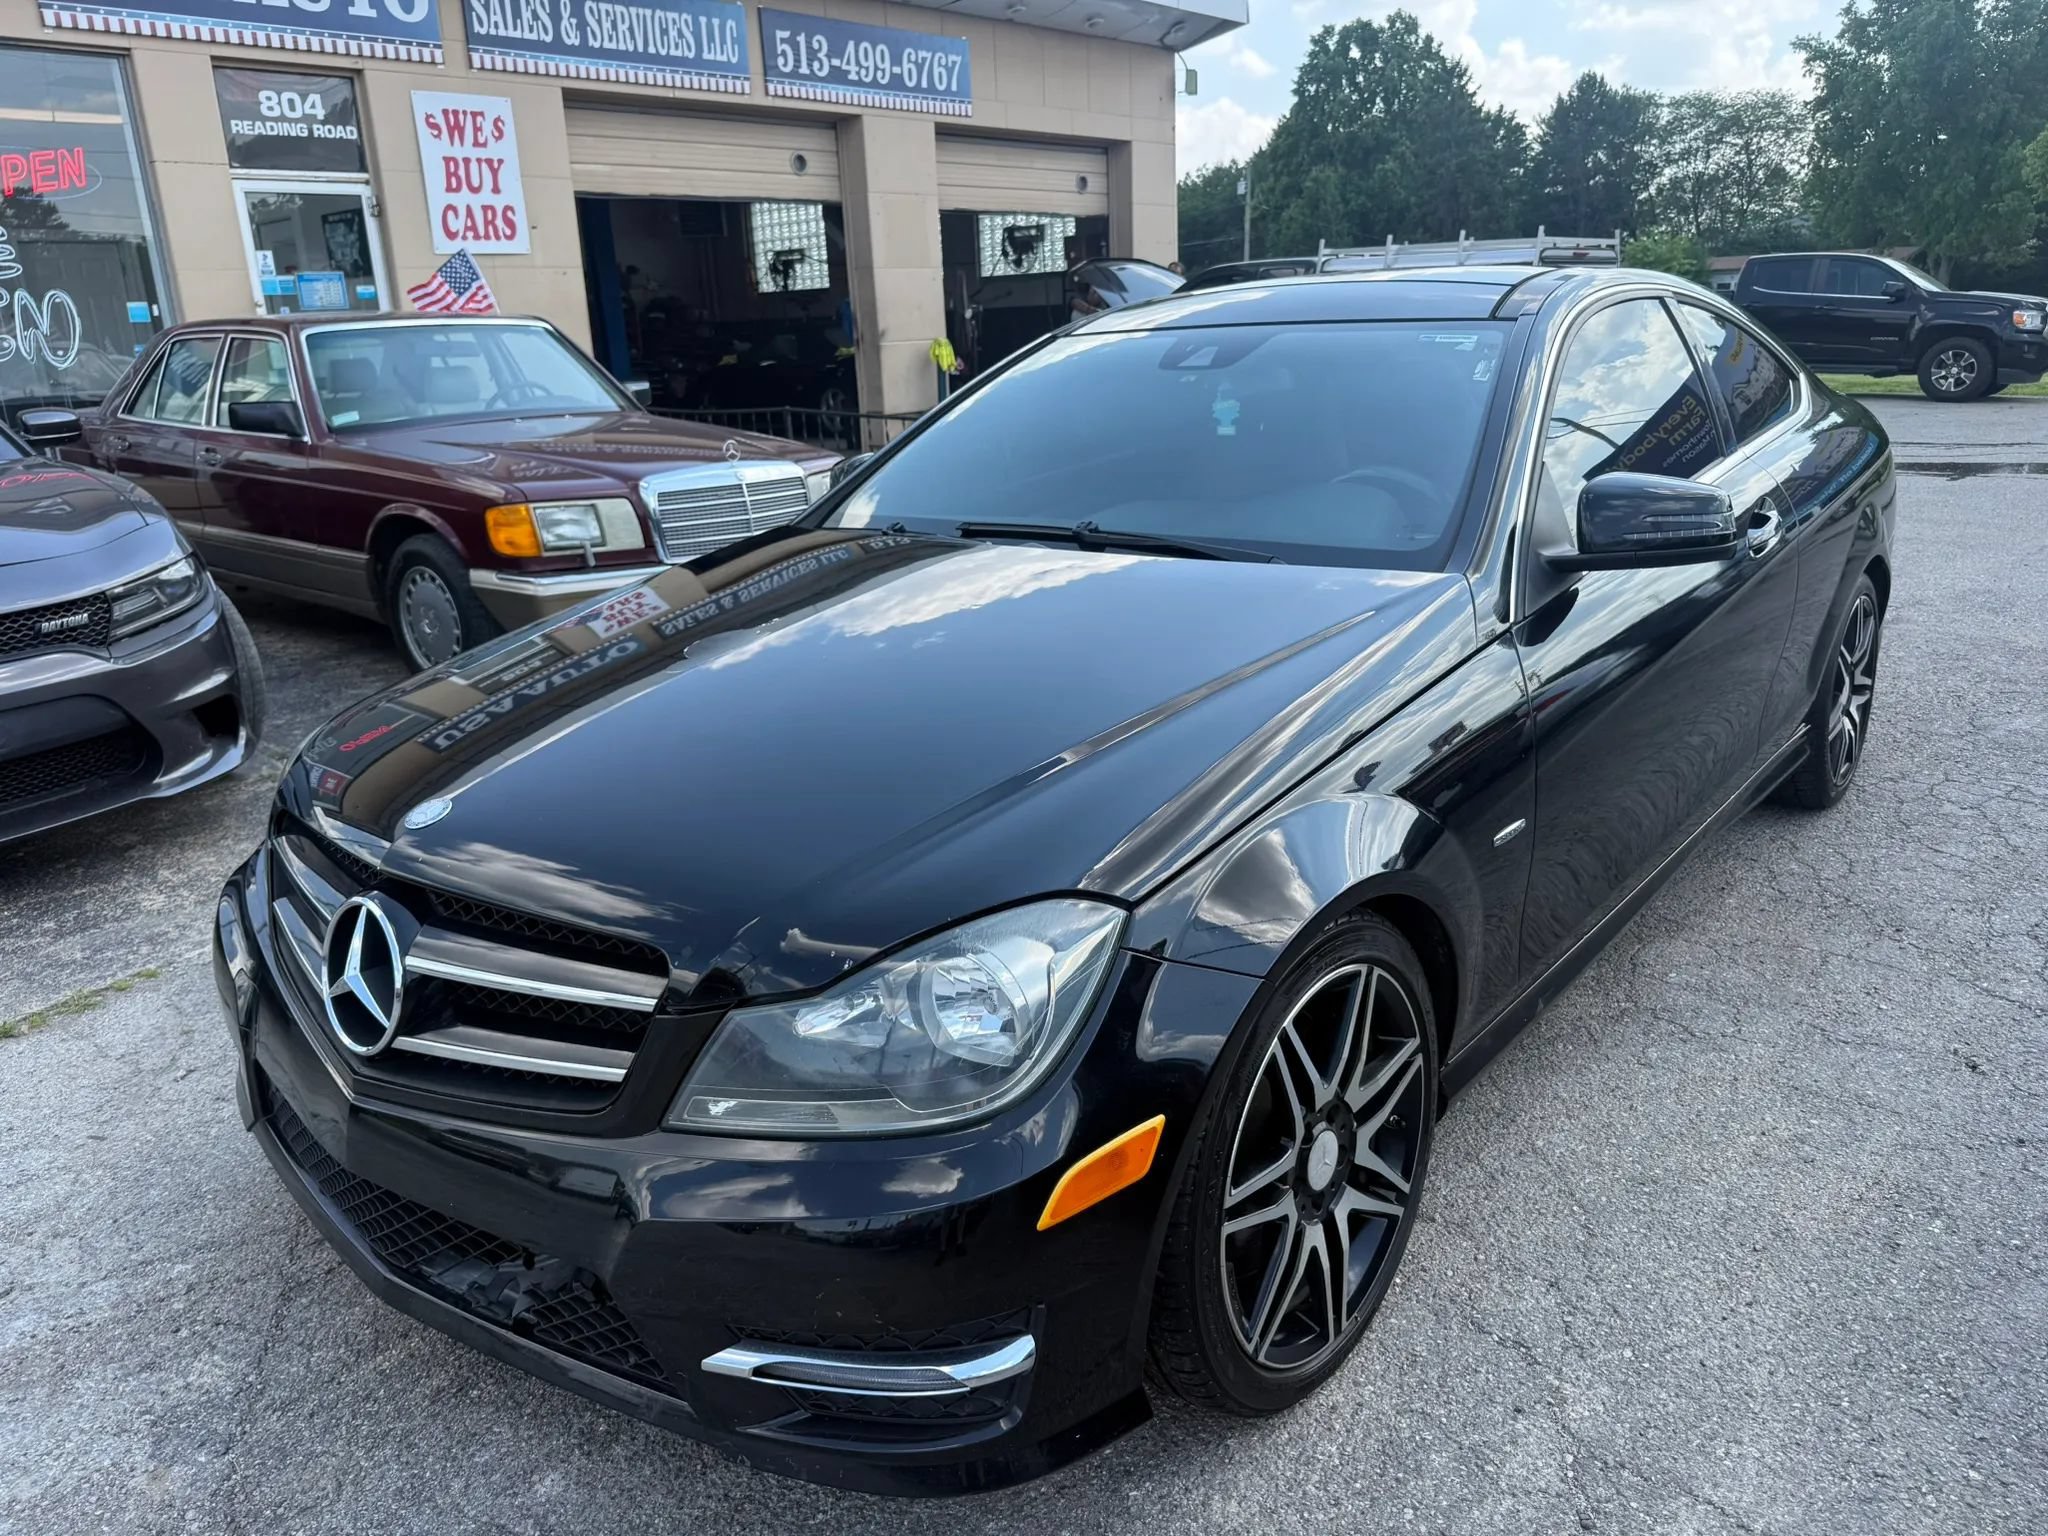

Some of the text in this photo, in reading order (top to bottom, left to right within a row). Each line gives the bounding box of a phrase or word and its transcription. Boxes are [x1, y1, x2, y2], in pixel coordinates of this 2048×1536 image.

[471, 0, 554, 42] SALES
[560, 0, 580, 46] &
[584, 1, 696, 59] SERVICES
[698, 16, 739, 64] LLC
[775, 29, 962, 92] 513-499-6767
[258, 89, 326, 120] 804
[230, 119, 359, 140] READING ROAD
[0, 147, 87, 198] PEN
[442, 156, 505, 195] BUY
[441, 203, 518, 241] CARS
[41, 613, 89, 634] DAYTONA
